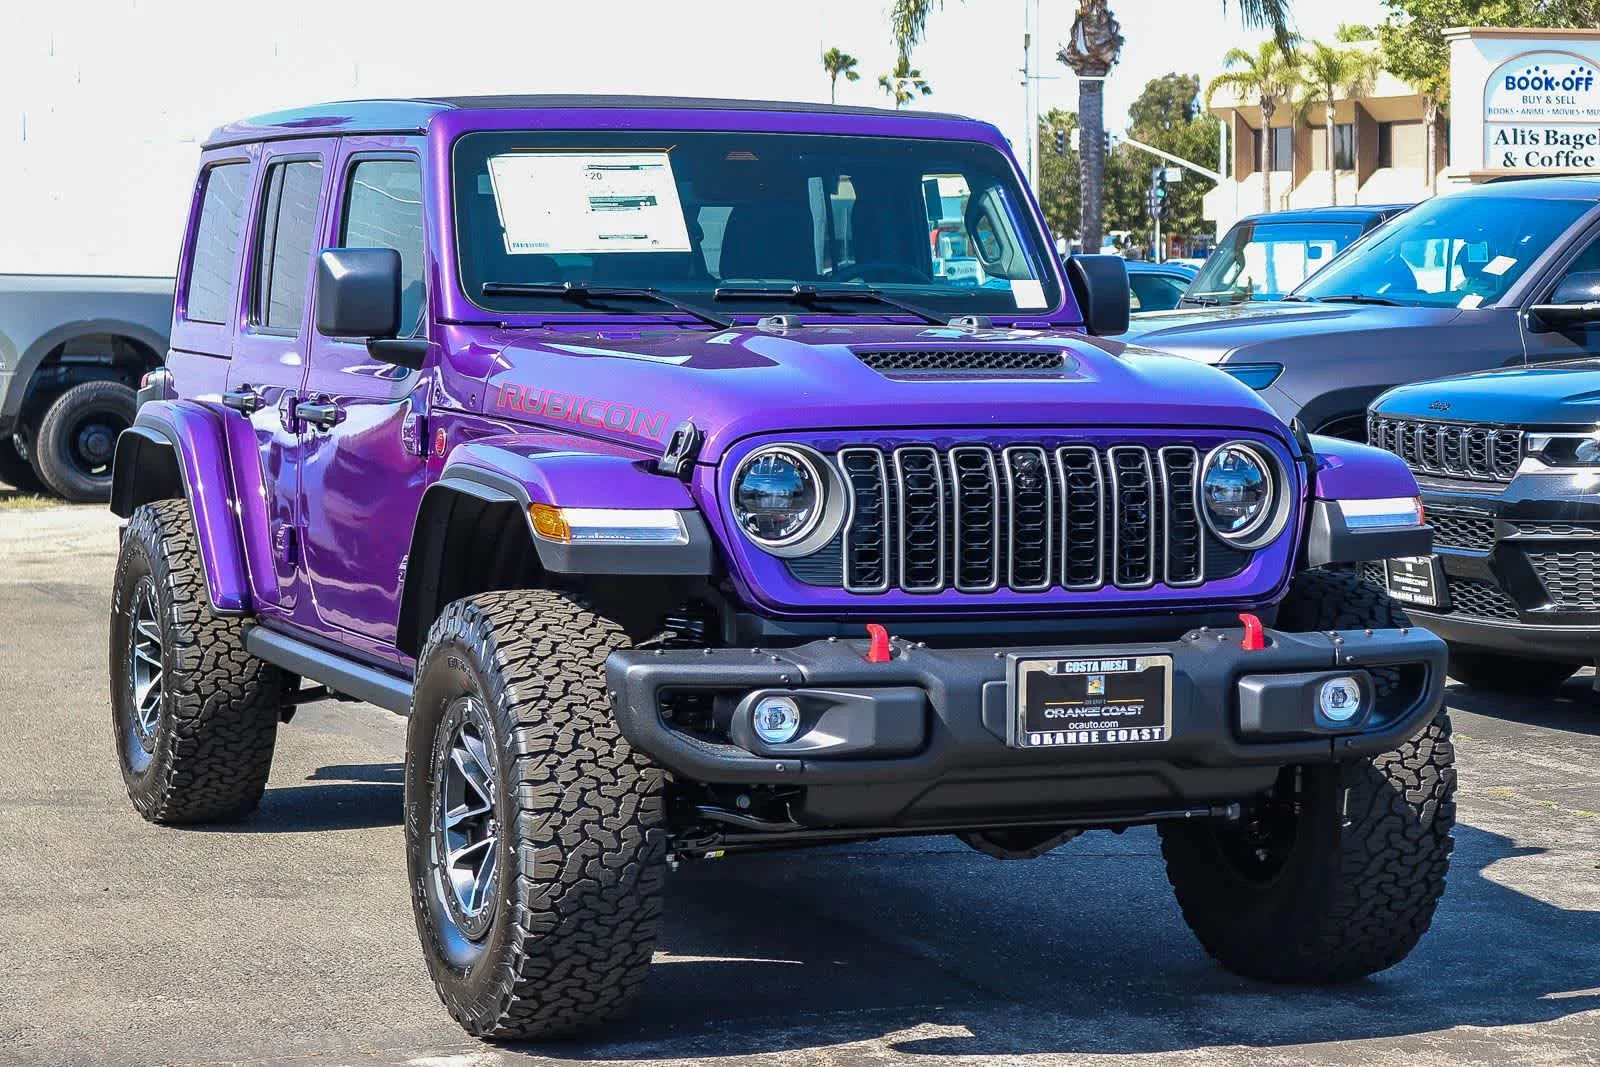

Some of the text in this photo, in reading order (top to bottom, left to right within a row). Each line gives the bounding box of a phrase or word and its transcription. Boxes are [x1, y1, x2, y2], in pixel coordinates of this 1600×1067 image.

[1522, 95, 1576, 105] BUY & SELL
[1552, 108, 1580, 116] MOVIES
[1494, 128, 1540, 146] Ali's
[1503, 151, 1595, 168] & Coffee
[497, 381, 669, 440] RUBICON
[1065, 660, 1128, 673] COSTA MESA
[1044, 704, 1144, 719] ORANGE COAST
[1068, 720, 1119, 730] ocauto.com
[1030, 728, 1162, 746] ORANGE COAST
